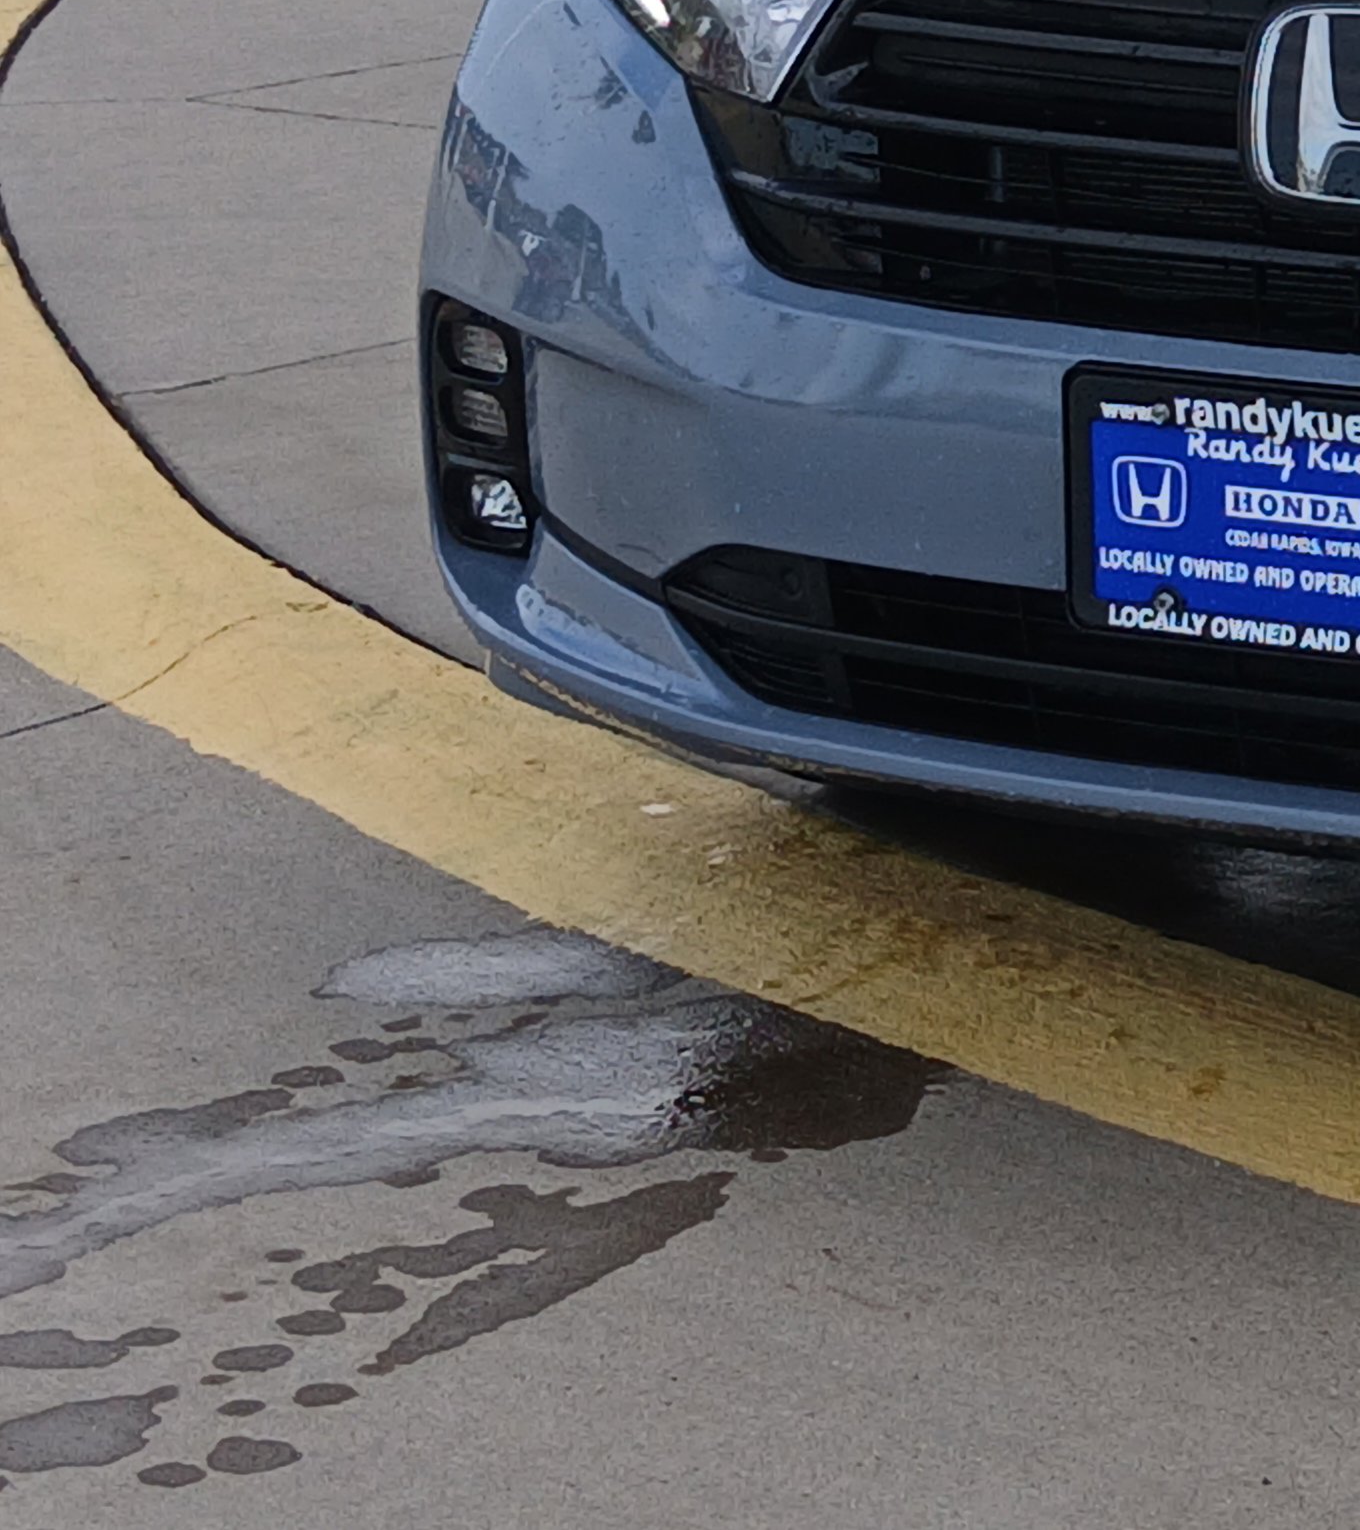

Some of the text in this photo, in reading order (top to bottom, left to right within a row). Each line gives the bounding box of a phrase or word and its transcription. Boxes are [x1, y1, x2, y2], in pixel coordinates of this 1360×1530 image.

[1184, 427, 1296, 483] Randy
[1231, 491, 1357, 524] HONDA
[1099, 546, 1174, 576] LOCALLY
[1180, 556, 1248, 583] OWNED
[1254, 566, 1294, 588] AND
[1108, 603, 1207, 636] LOCALLY
[1211, 616, 1296, 646] OWNED
[1300, 627, 1351, 653] AND
